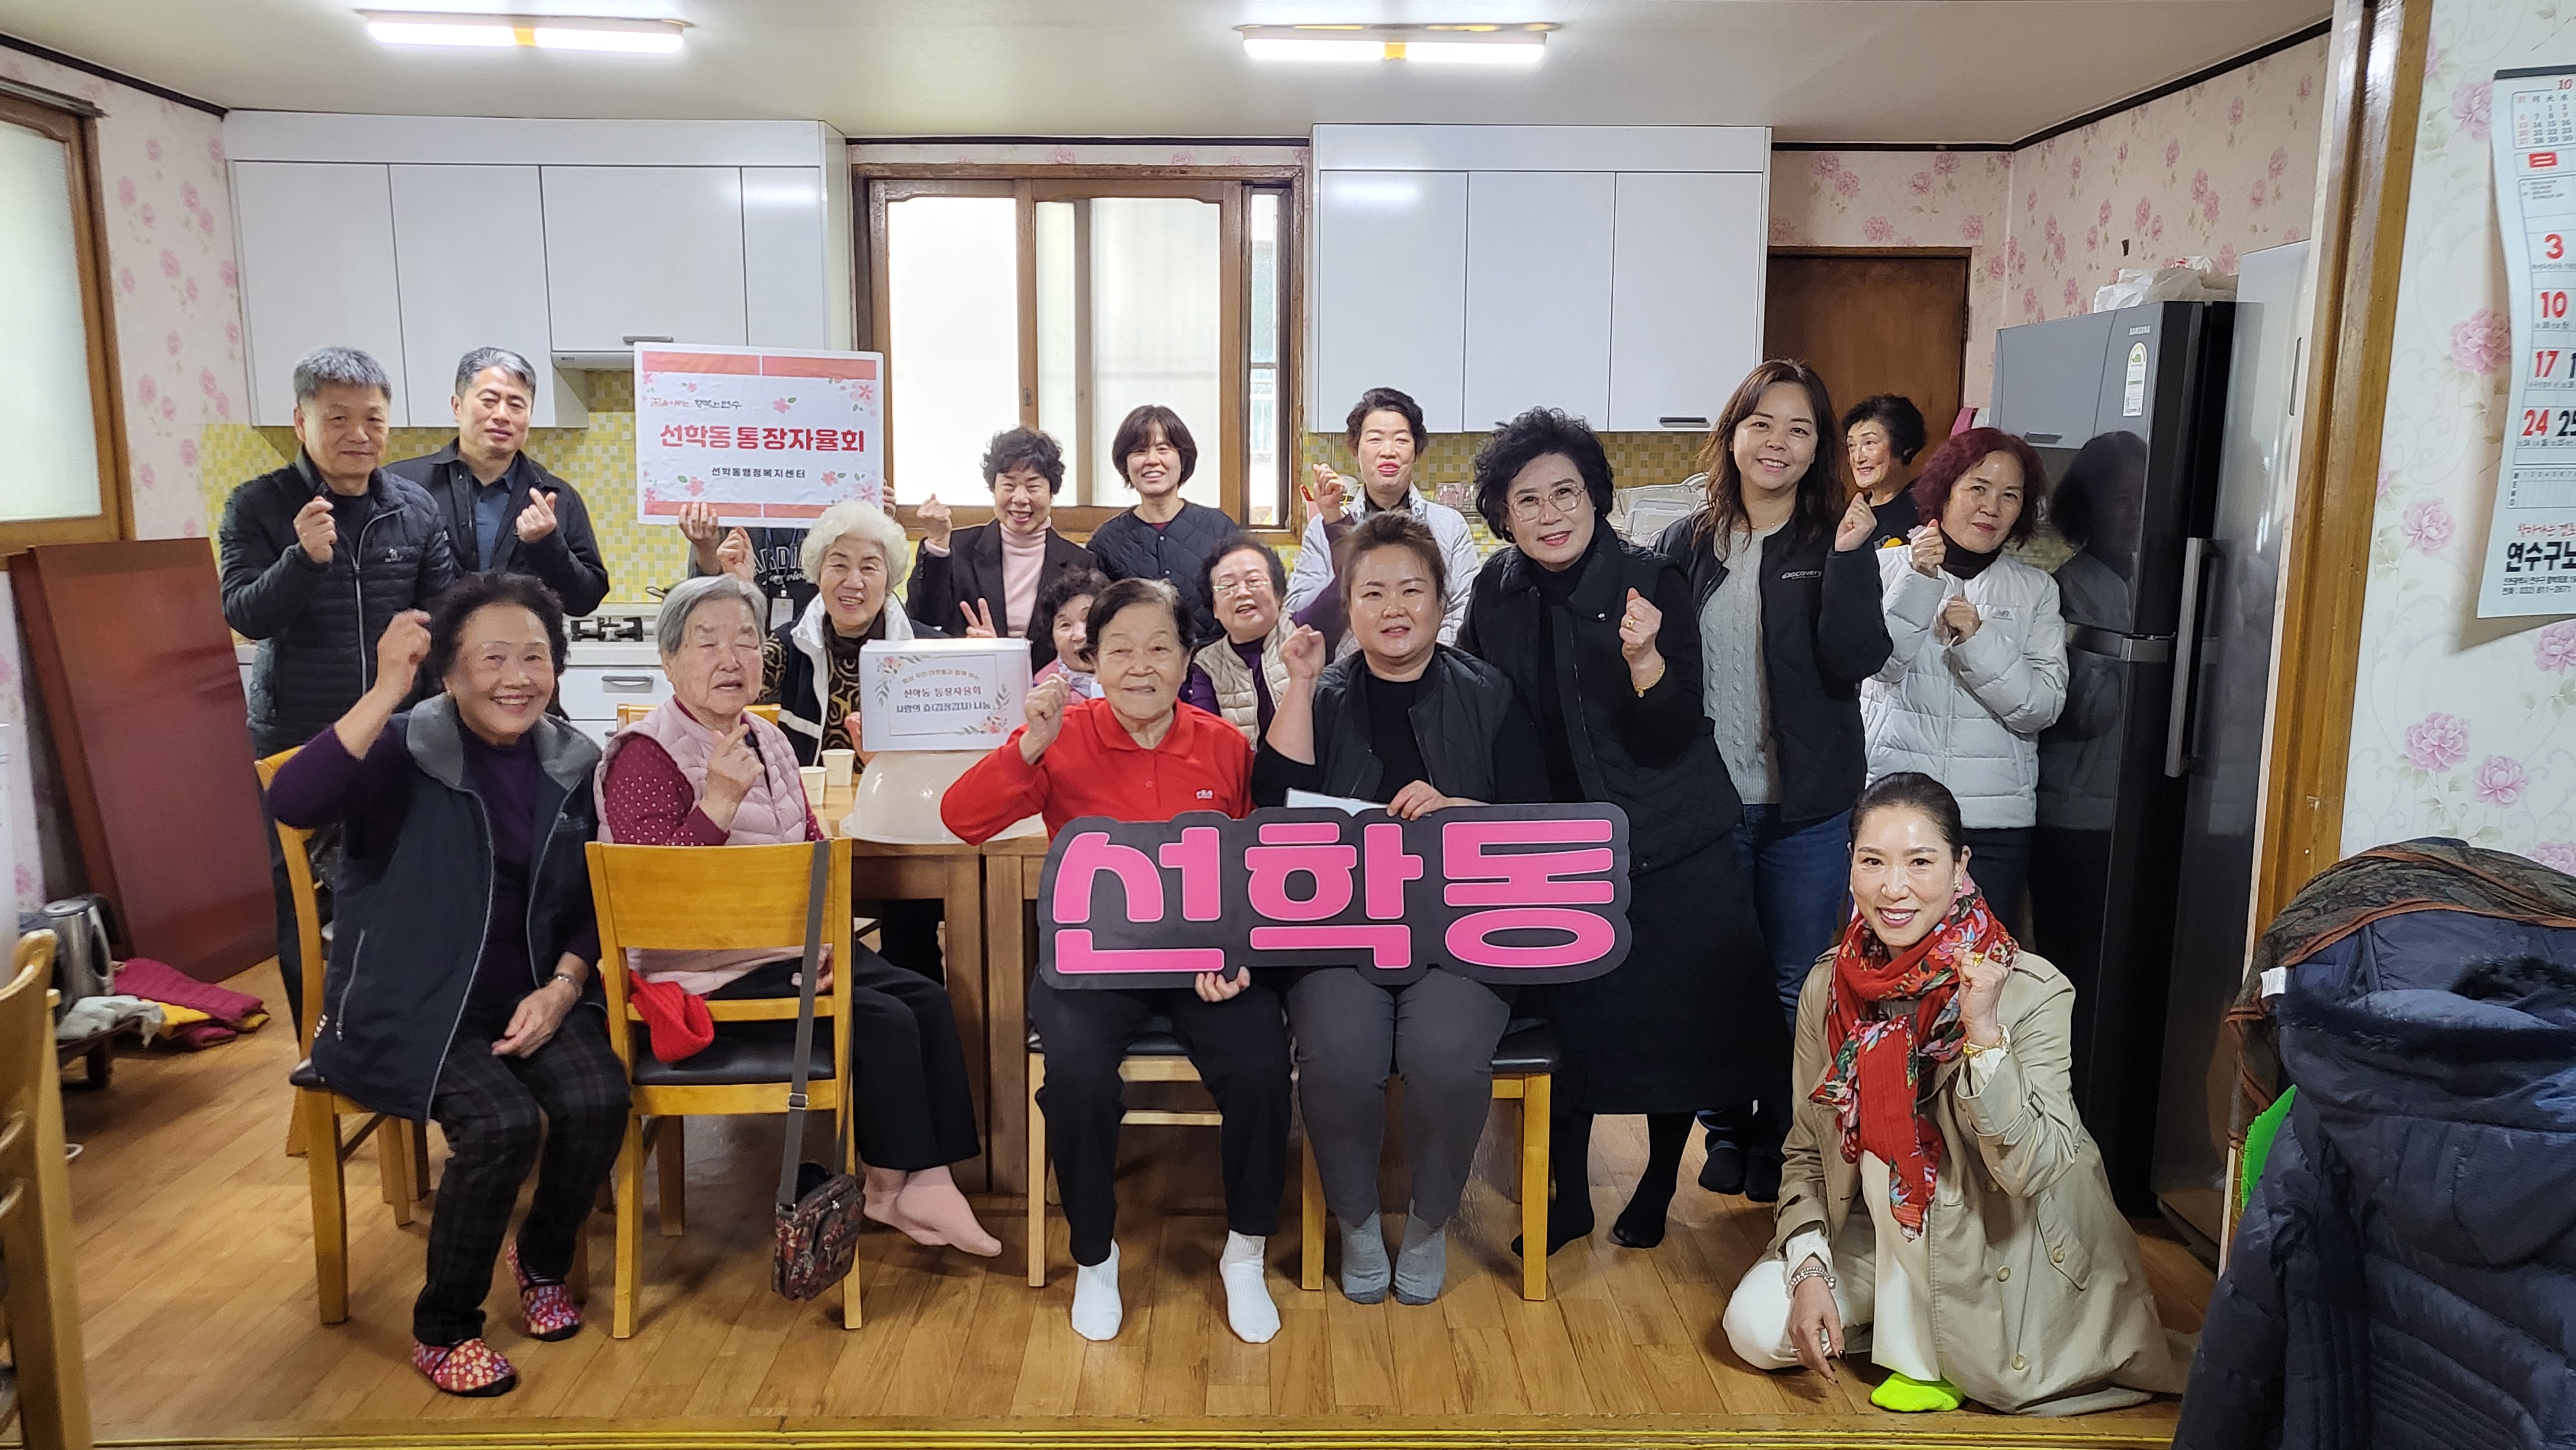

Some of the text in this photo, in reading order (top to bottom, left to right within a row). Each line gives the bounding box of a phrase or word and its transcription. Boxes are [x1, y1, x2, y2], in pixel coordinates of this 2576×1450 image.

[2557, 79, 2573, 90] 10
[2544, 234, 2564, 259] 3
[2540, 292, 2568, 318] 10
[2128, 326, 2151, 335] SAMSUNG
[2535, 350, 2576, 379] 17 1
[2521, 409, 2550, 436] 24
[660, 424, 865, 452] 선학동 통장자율회
[712, 467, 806, 479] 선학동행정복지센터
[1054, 820, 1615, 974] 선학동
